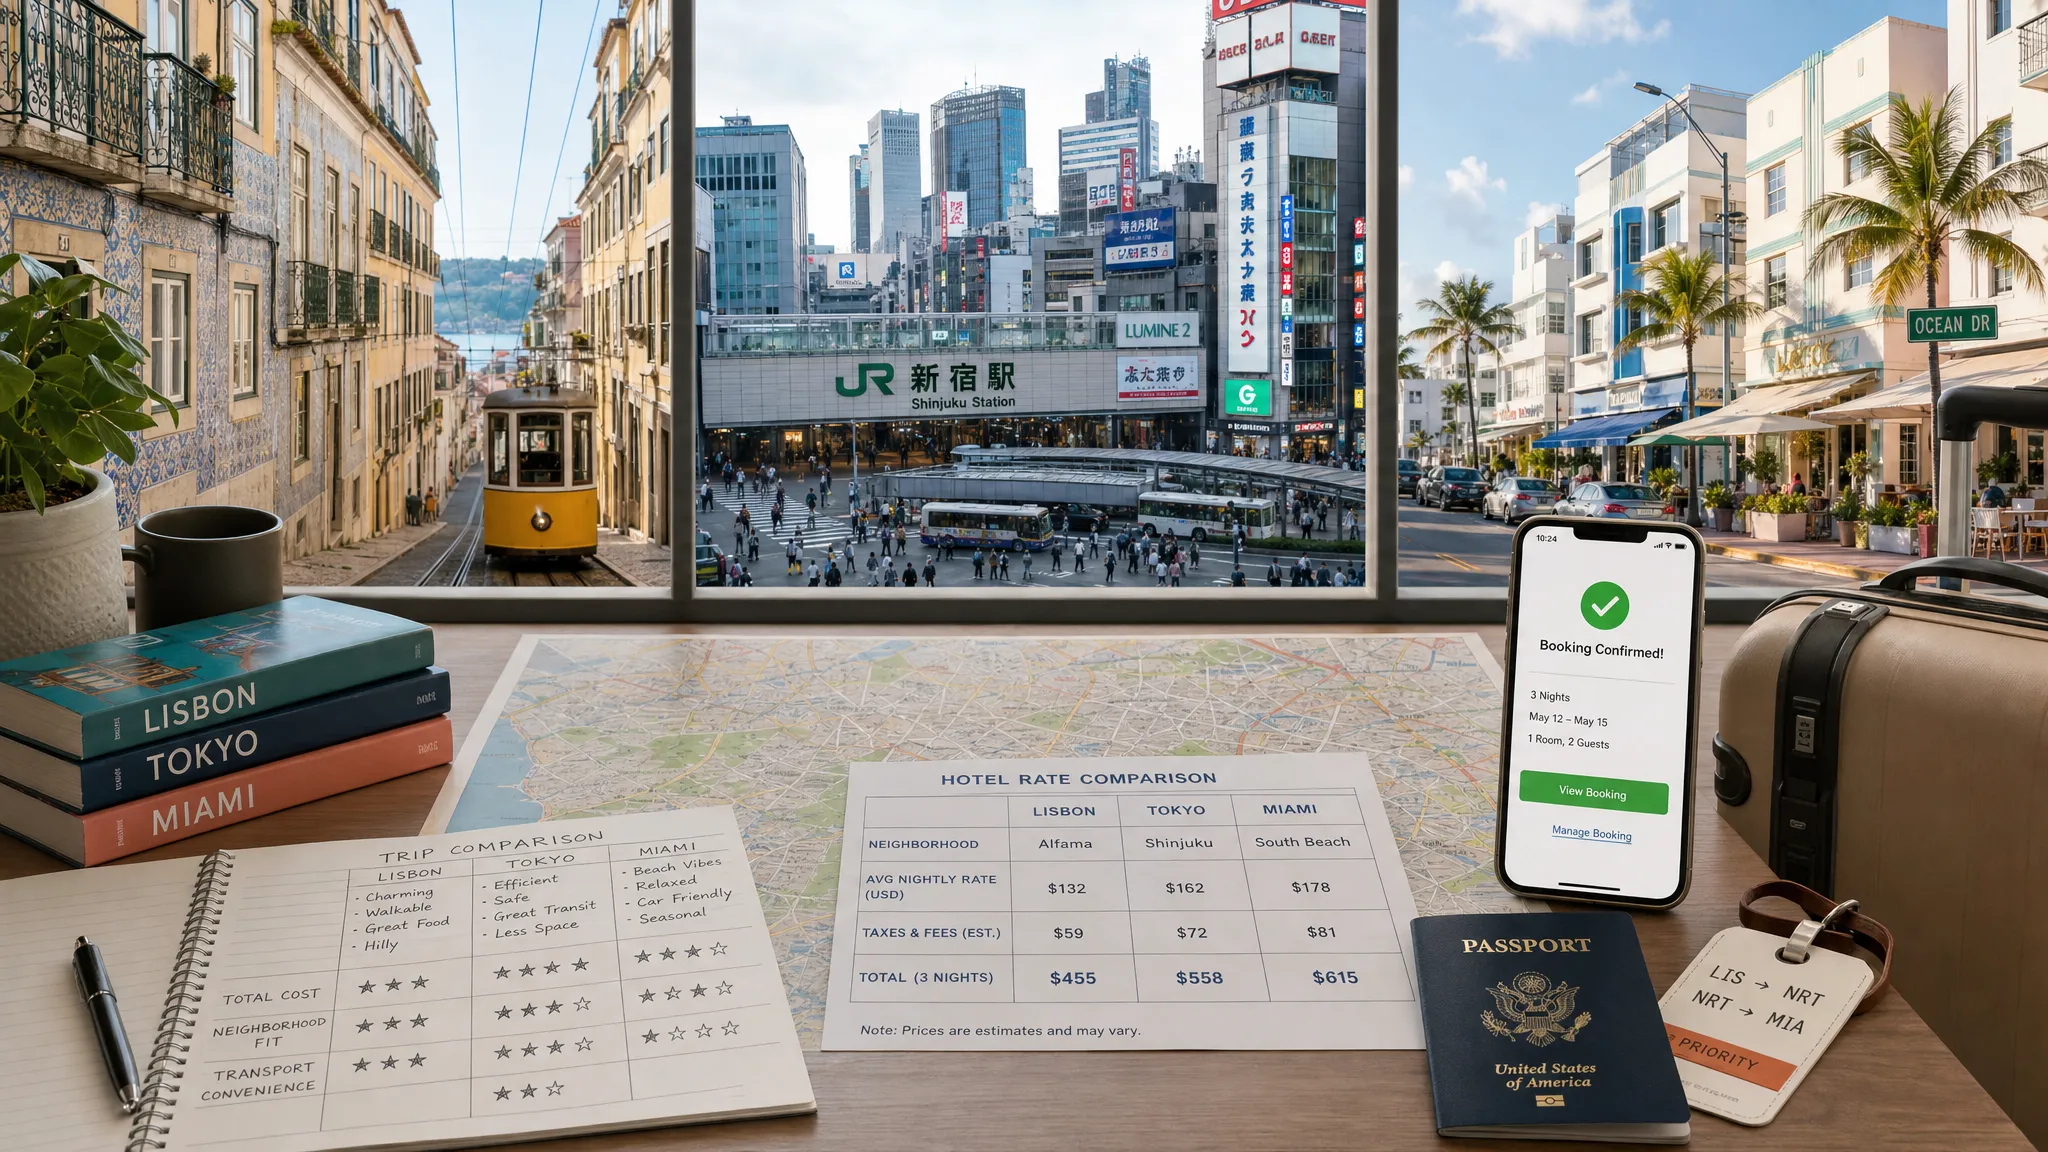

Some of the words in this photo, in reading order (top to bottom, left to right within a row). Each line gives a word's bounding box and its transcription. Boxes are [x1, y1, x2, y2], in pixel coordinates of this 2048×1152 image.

[1125, 323, 1179, 339] LUMINE
[1182, 323, 1190, 338] 2
[1915, 315, 1963, 334] OCEAN
[1971, 314, 1990, 332] DR
[835, 362, 895, 398] JR
[910, 362, 1016, 393] 新宿駅
[1238, 384, 1257, 405] G
[911, 397, 967, 411] Shinjuku
[972, 396, 1016, 408] Station
[1536, 534, 1557, 543] 10:24
[1539, 639, 1592, 656] Booking
[1595, 643, 1664, 659] Confirmed!
[1530, 690, 1537, 700] 3
[1539, 691, 1571, 703] Nights
[145, 682, 256, 733] LISBON
[1529, 711, 1550, 724] May
[1552, 714, 1563, 723] 12
[1574, 716, 1594, 728] May
[1597, 717, 1608, 727] 15
[1528, 733, 1533, 743] 1
[1535, 734, 1565, 747] Room,
[1568, 737, 1574, 747] 2
[1577, 737, 1610, 749] Guests
[146, 729, 258, 781] TOKYO
[941, 774, 1010, 785] HOTEL
[1019, 773, 1071, 785] RATE
[1080, 772, 1217, 785] COMPARISON
[1559, 784, 1583, 796] View
[1586, 786, 1627, 802] Booking
[153, 784, 254, 836] MIAMI
[1033, 806, 1096, 817] LISBON
[1147, 805, 1206, 816] TOKYO
[1263, 804, 1318, 814] MIAMI
[1552, 825, 1590, 838] Manage
[1593, 828, 1632, 843] Booking
[379, 848, 434, 863] TRIP
[450, 831, 603, 855] COMPARISON
[639, 842, 696, 857] MIAMI
[869, 840, 979, 849] NEIGHBORHOOD
[1039, 838, 1093, 850] Alfama
[1145, 838, 1213, 850] Shinjuku
[1255, 836, 1300, 848] South
[1305, 836, 1351, 847] Beach
[506, 854, 575, 869] TOKYO
[633, 863, 676, 876] Beach
[683, 857, 722, 869] Vibes
[378, 867, 442, 882] LISBON
[494, 874, 559, 890] Efficient
[636, 874, 697, 891] Relaxed
[866, 875, 894, 884] AVG
[898, 875, 956, 884] NIGHTLY
[961, 875, 997, 884] RATE
[366, 888, 434, 903] Charming
[865, 889, 904, 901] (USD)
[1048, 882, 1086, 895] $132
[1165, 882, 1205, 895] $162
[1291, 881, 1331, 894] $178
[494, 893, 531, 906] Safe
[637, 896, 664, 908] Car
[672, 888, 733, 904] Friendly
[366, 902, 433, 917] Walkable
[494, 908, 537, 922] Great
[544, 900, 597, 915] Transit
[639, 907, 707, 924] Seasonal
[365, 920, 409, 935] Great
[417, 916, 450, 930] Food
[495, 927, 527, 939] Less
[535, 920, 579, 936] Space
[862, 928, 906, 939] TAXES
[910, 928, 919, 938] &
[924, 928, 957, 938] FEES
[962, 927, 1001, 940] (EST.)
[1053, 927, 1084, 940] $59
[1177, 927, 1208, 940] $72
[1307, 925, 1336, 939] $81
[364, 939, 399, 953] Hilly
[1461, 938, 1591, 953] PASSPORT
[859, 972, 907, 983] TOTAL
[914, 971, 929, 985] (3
[933, 971, 994, 985] NIGHTS)
[1050, 971, 1097, 986] $455
[1176, 970, 1224, 986] $558
[1312, 970, 1358, 985] $615
[1709, 964, 1746, 985] LIS
[1782, 985, 1826, 1008] NRT
[223, 992, 273, 1005] TOTAL
[281, 988, 321, 1000] COST
[1691, 989, 1734, 1011] NRT
[1765, 1011, 1805, 1035] MIA
[213, 1017, 327, 1038] NEIGHBORHOOD
[860, 1025, 897, 1036] Note:
[902, 1025, 944, 1036] Prices
[949, 1027, 971, 1036] are
[975, 1025, 1043, 1036] estimates
[1047, 1025, 1072, 1036] and
[1076, 1027, 1103, 1039] may
[1108, 1027, 1141, 1038] vary.
[254, 1036, 284, 1048] FIT
[1678, 1036, 1760, 1071] PRIORITY
[214, 1061, 316, 1082] TRANSPORT
[1495, 1063, 1547, 1075] United
[1551, 1063, 1596, 1074] States
[201, 1080, 316, 1101] CONVENIENCE
[1506, 1077, 1524, 1091] of
[1526, 1076, 1592, 1089] America
